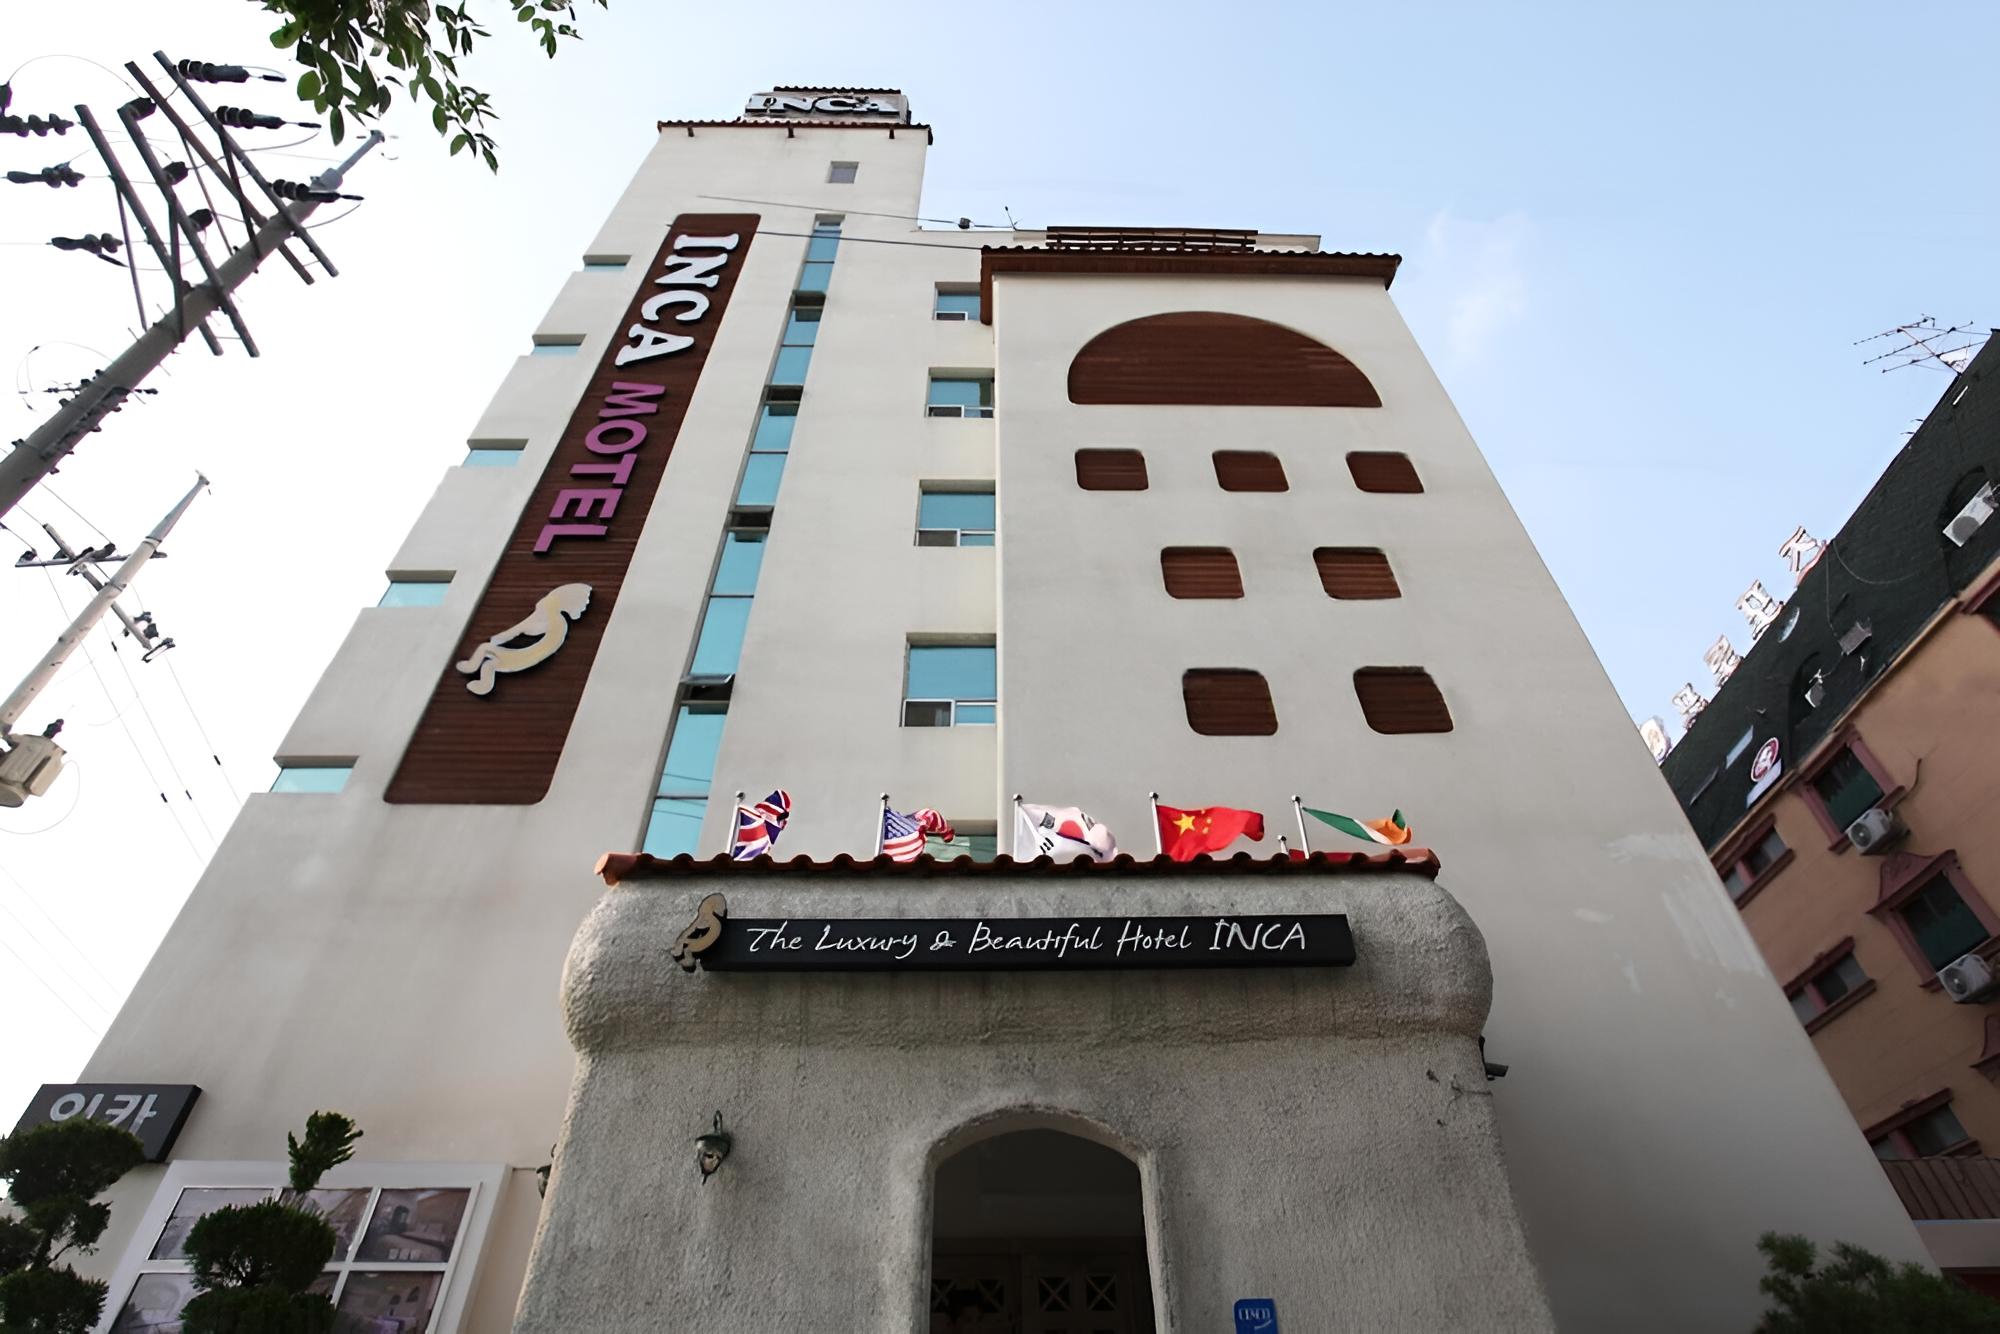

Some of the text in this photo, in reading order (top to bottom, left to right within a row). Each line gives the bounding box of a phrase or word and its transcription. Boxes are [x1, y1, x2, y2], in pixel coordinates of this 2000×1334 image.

[745, 95, 900, 115] INCA
[532, 233, 740, 555] INCA MOTEL
[746, 917, 1306, 960] The Luxury & Beautiful Hotel INCA
